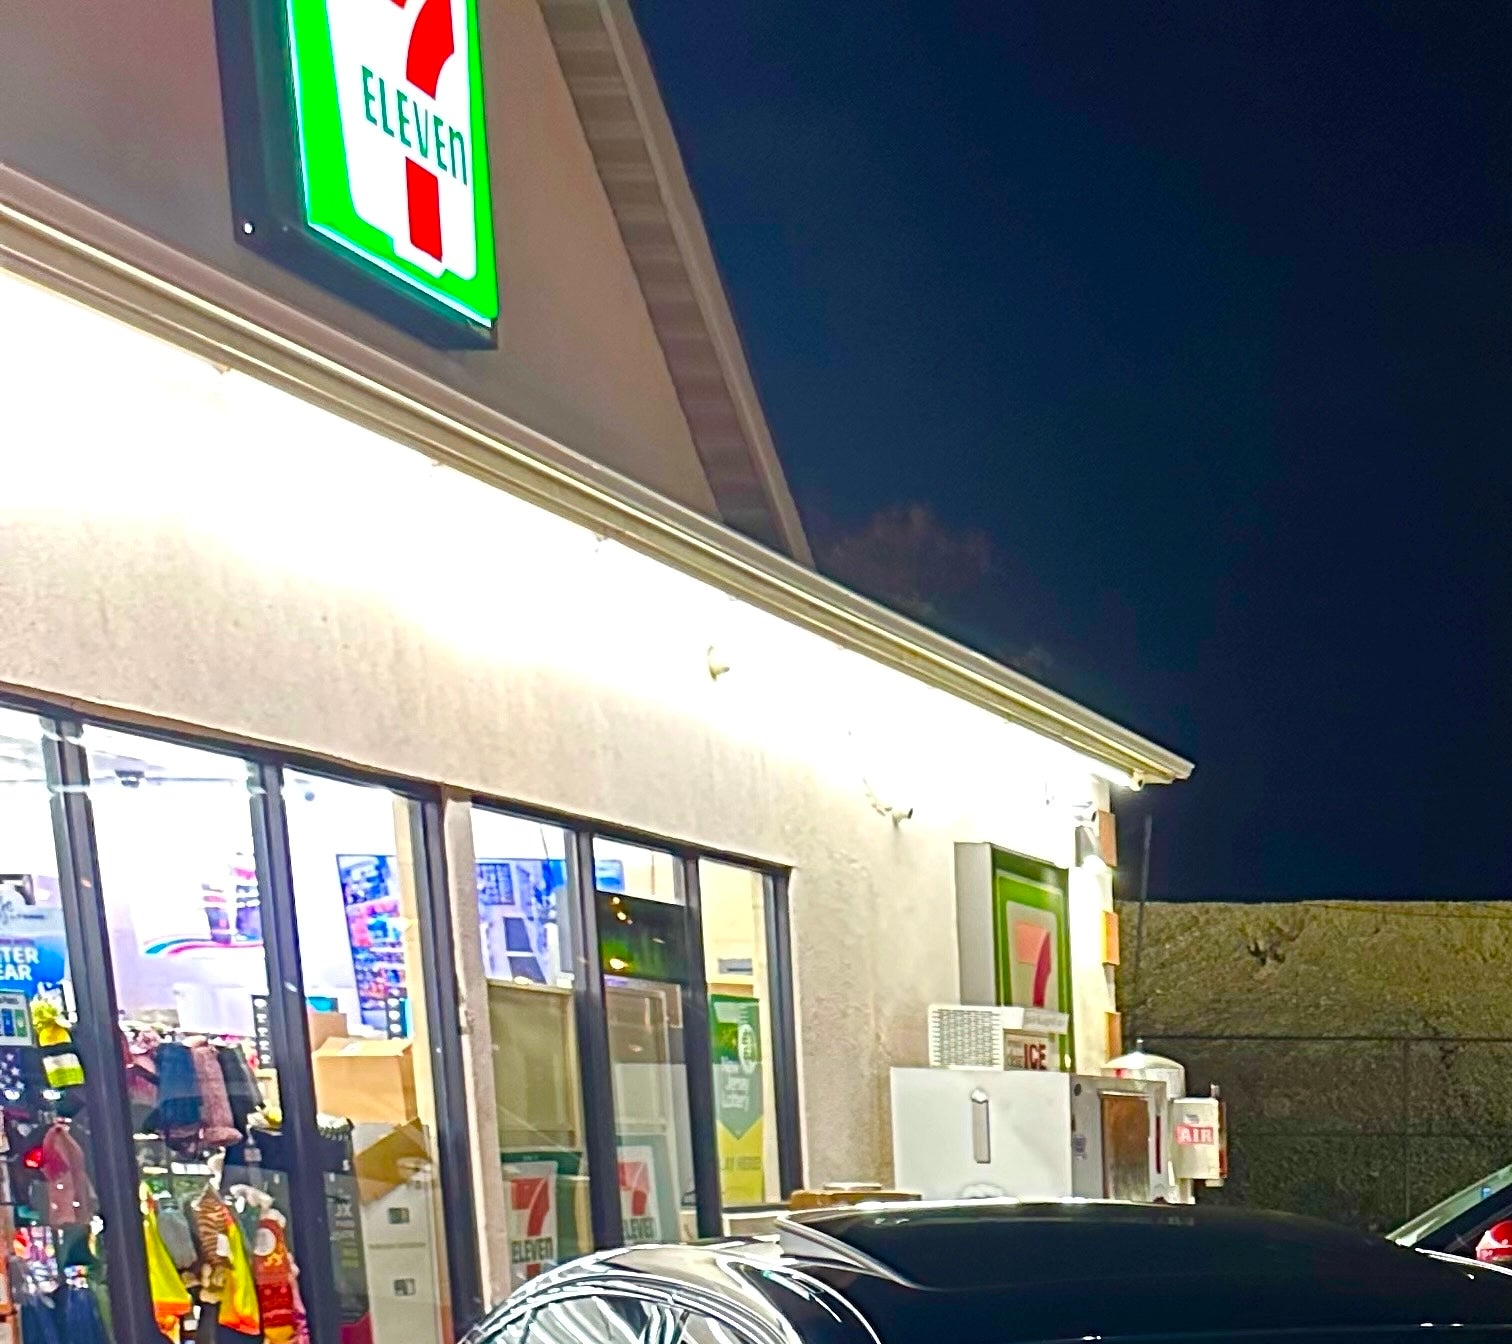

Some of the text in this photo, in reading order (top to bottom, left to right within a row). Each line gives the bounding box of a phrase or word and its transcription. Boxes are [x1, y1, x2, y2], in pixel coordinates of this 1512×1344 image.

[0, 945, 40, 965] TER
[1014, 918, 1052, 1008] 7
[1023, 1043, 1047, 1071] ICE
[1179, 1128, 1214, 1144] AIR
[511, 1176, 550, 1237] 7
